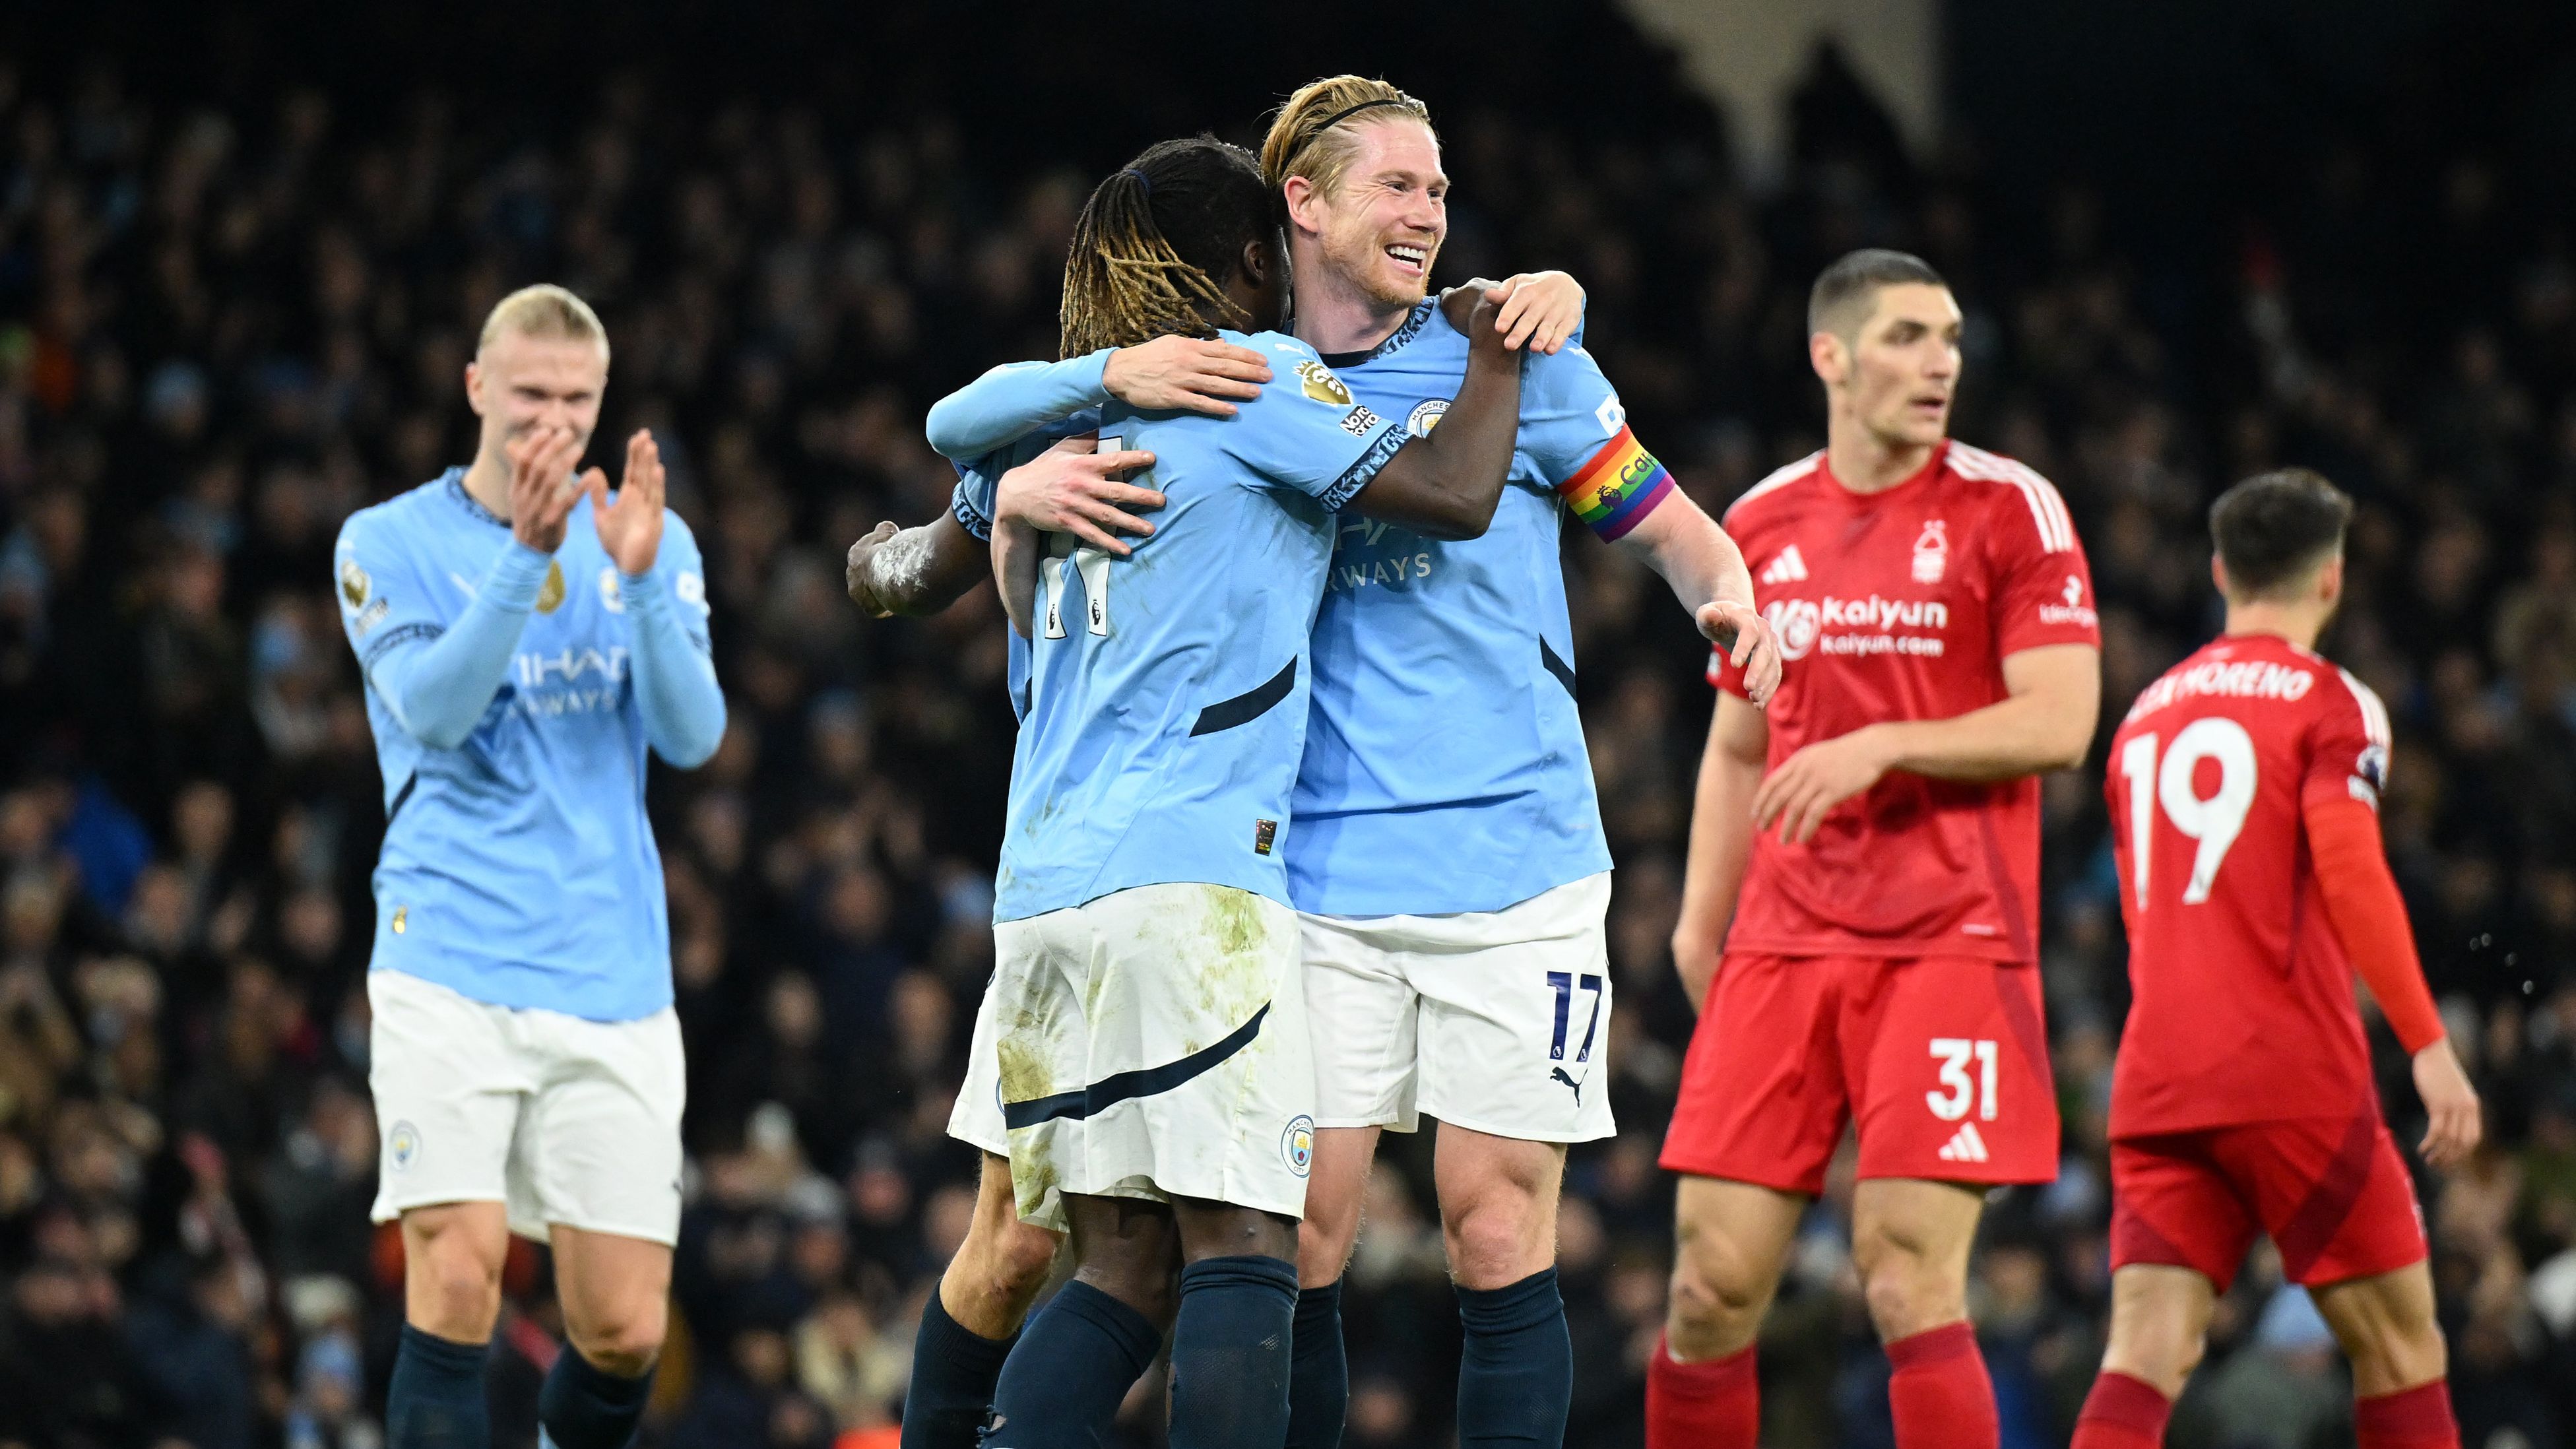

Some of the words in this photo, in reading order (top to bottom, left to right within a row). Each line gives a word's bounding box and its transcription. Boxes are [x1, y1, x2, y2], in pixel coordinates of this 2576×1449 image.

[1339, 415, 1361, 432] No
[1412, 402, 1450, 421] MANCHES
[1326, 552, 1431, 593] RWAYS
[2121, 717, 2257, 913] 19
[1547, 971, 1603, 1063] 17
[1925, 1037, 1998, 1122] 31
